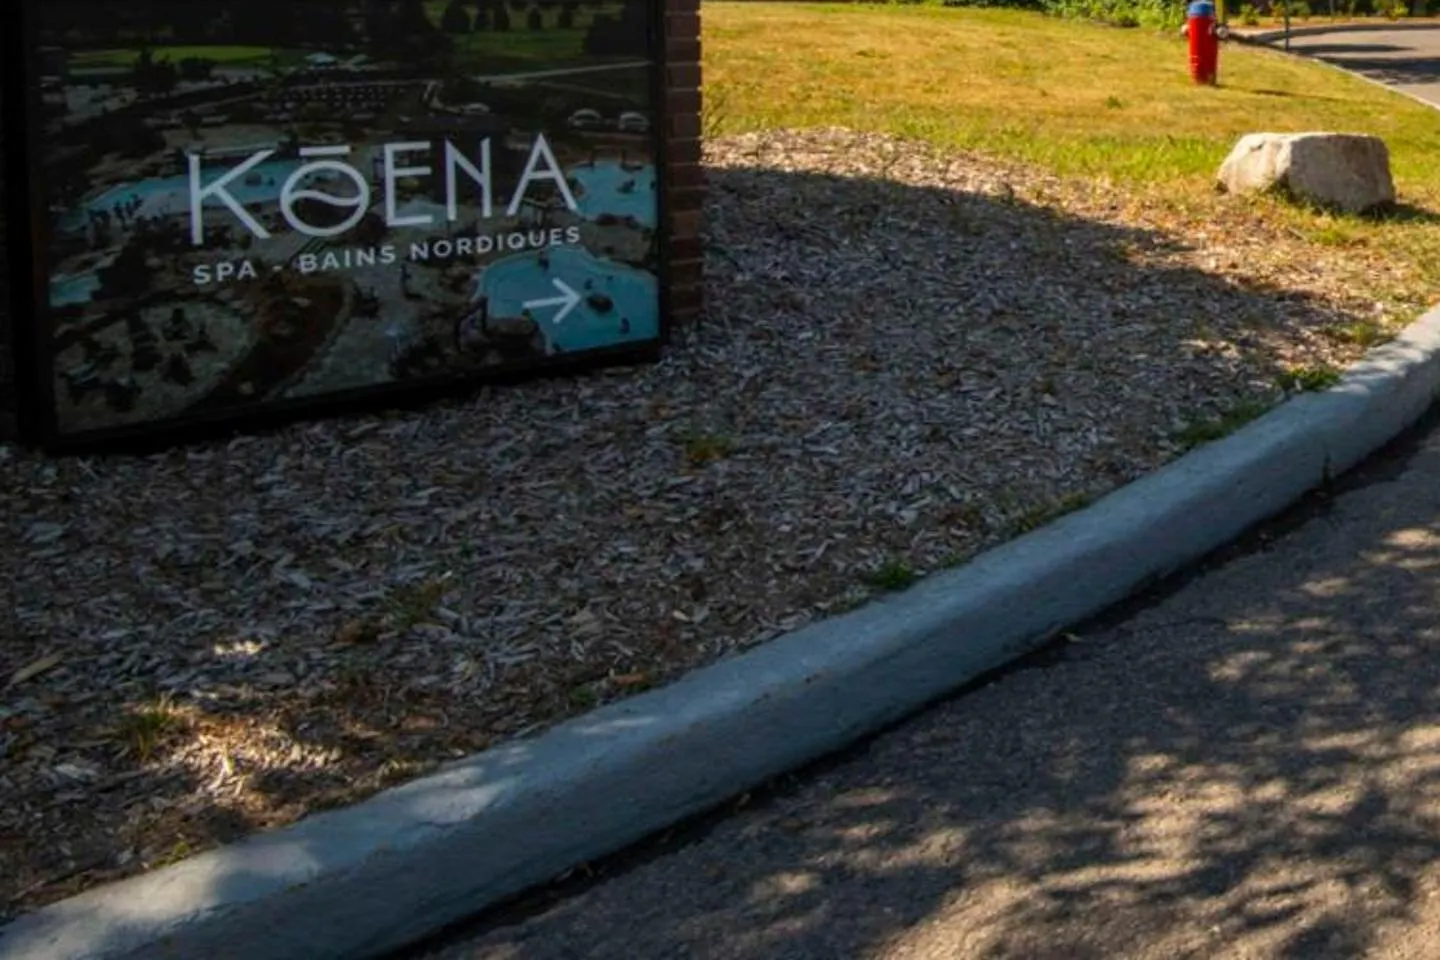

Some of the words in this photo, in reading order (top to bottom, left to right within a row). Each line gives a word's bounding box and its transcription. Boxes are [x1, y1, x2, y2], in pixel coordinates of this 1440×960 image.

[192, 259, 258, 286] SPA
[299, 245, 397, 275] BAINS
[410, 226, 582, 264] NORDIQUES
